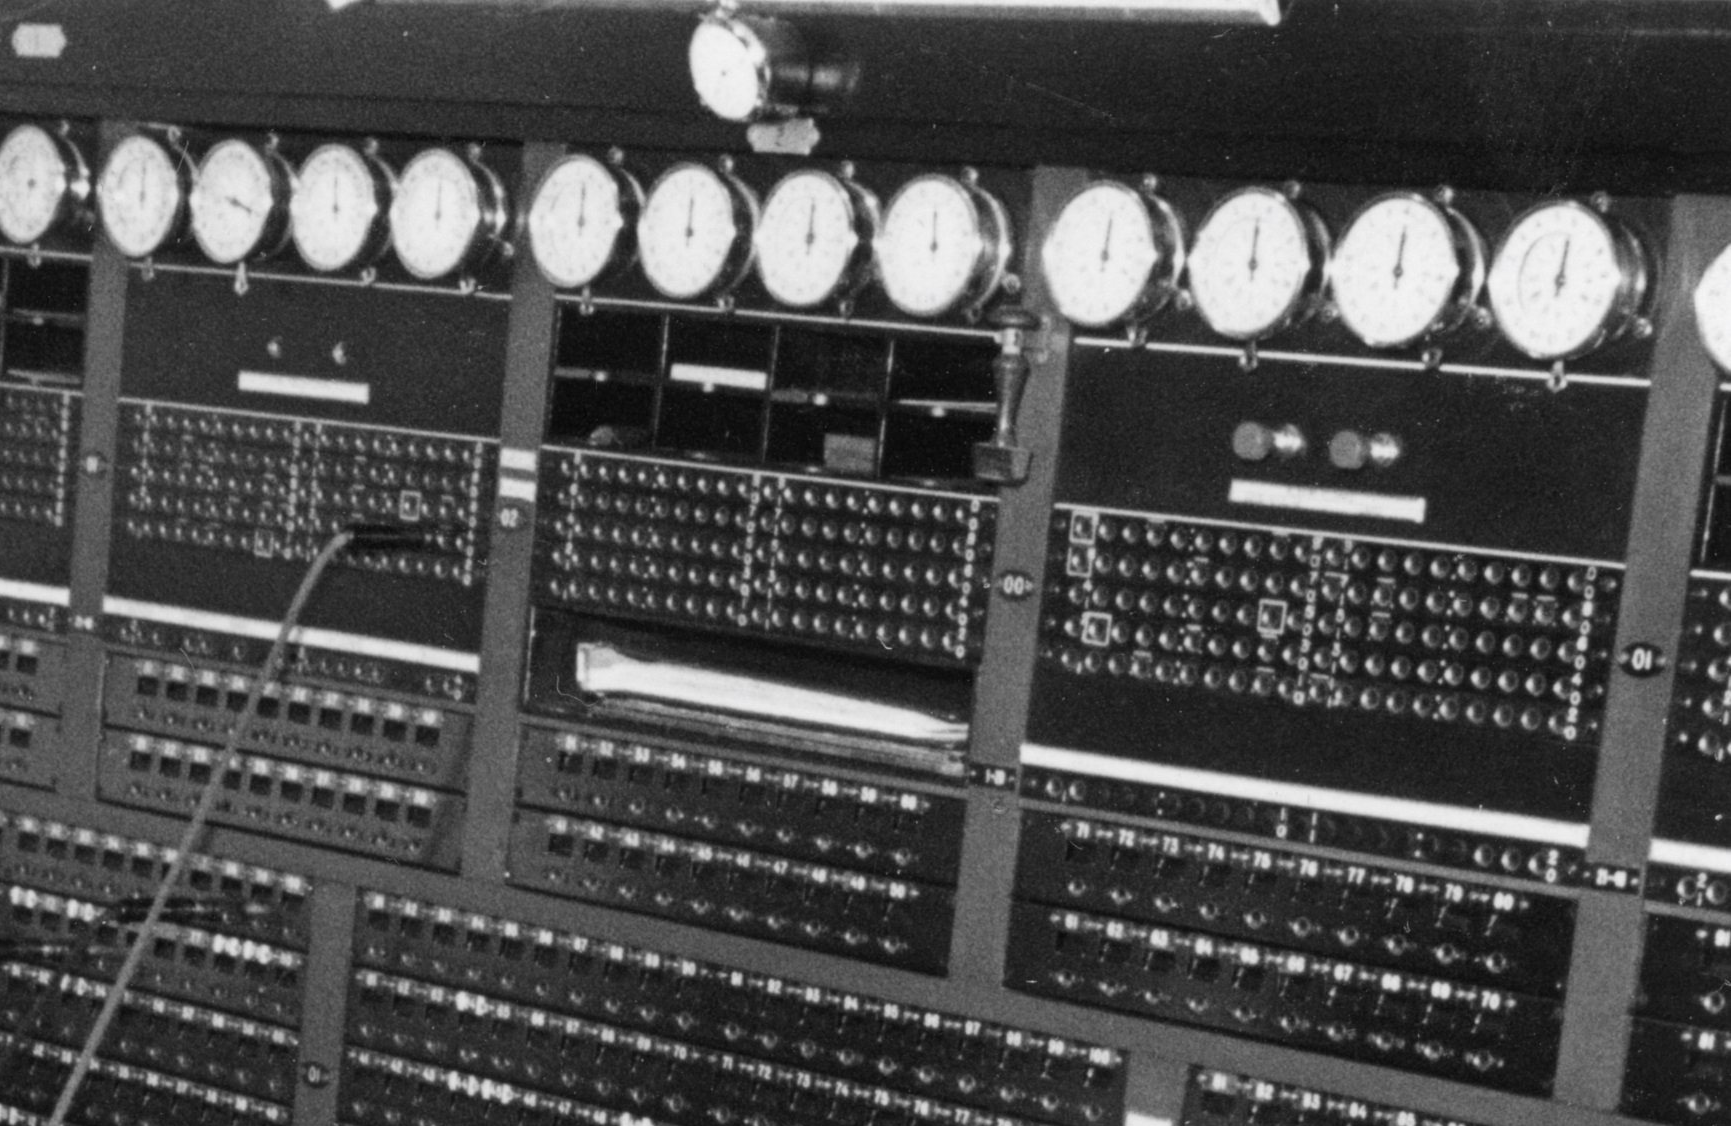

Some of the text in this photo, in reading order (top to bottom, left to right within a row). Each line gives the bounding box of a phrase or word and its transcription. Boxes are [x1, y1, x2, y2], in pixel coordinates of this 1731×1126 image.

[499, 509, 518, 527] 02
[1001, 576, 1026, 594] 00
[1632, 648, 1652, 669] 01
[1077, 822, 1514, 910] 71 72 73 74 75 76 77 78 79 80
[1065, 914, 1500, 1009] 61 62 63 64 65 66 67 68 69 70
[308, 1065, 321, 1083] 01
[1212, 1073, 1227, 1090] 81
[1256, 1082, 1273, 1100] 82
[1302, 1092, 1320, 1109] 83
[1349, 1102, 1366, 1118] 84
